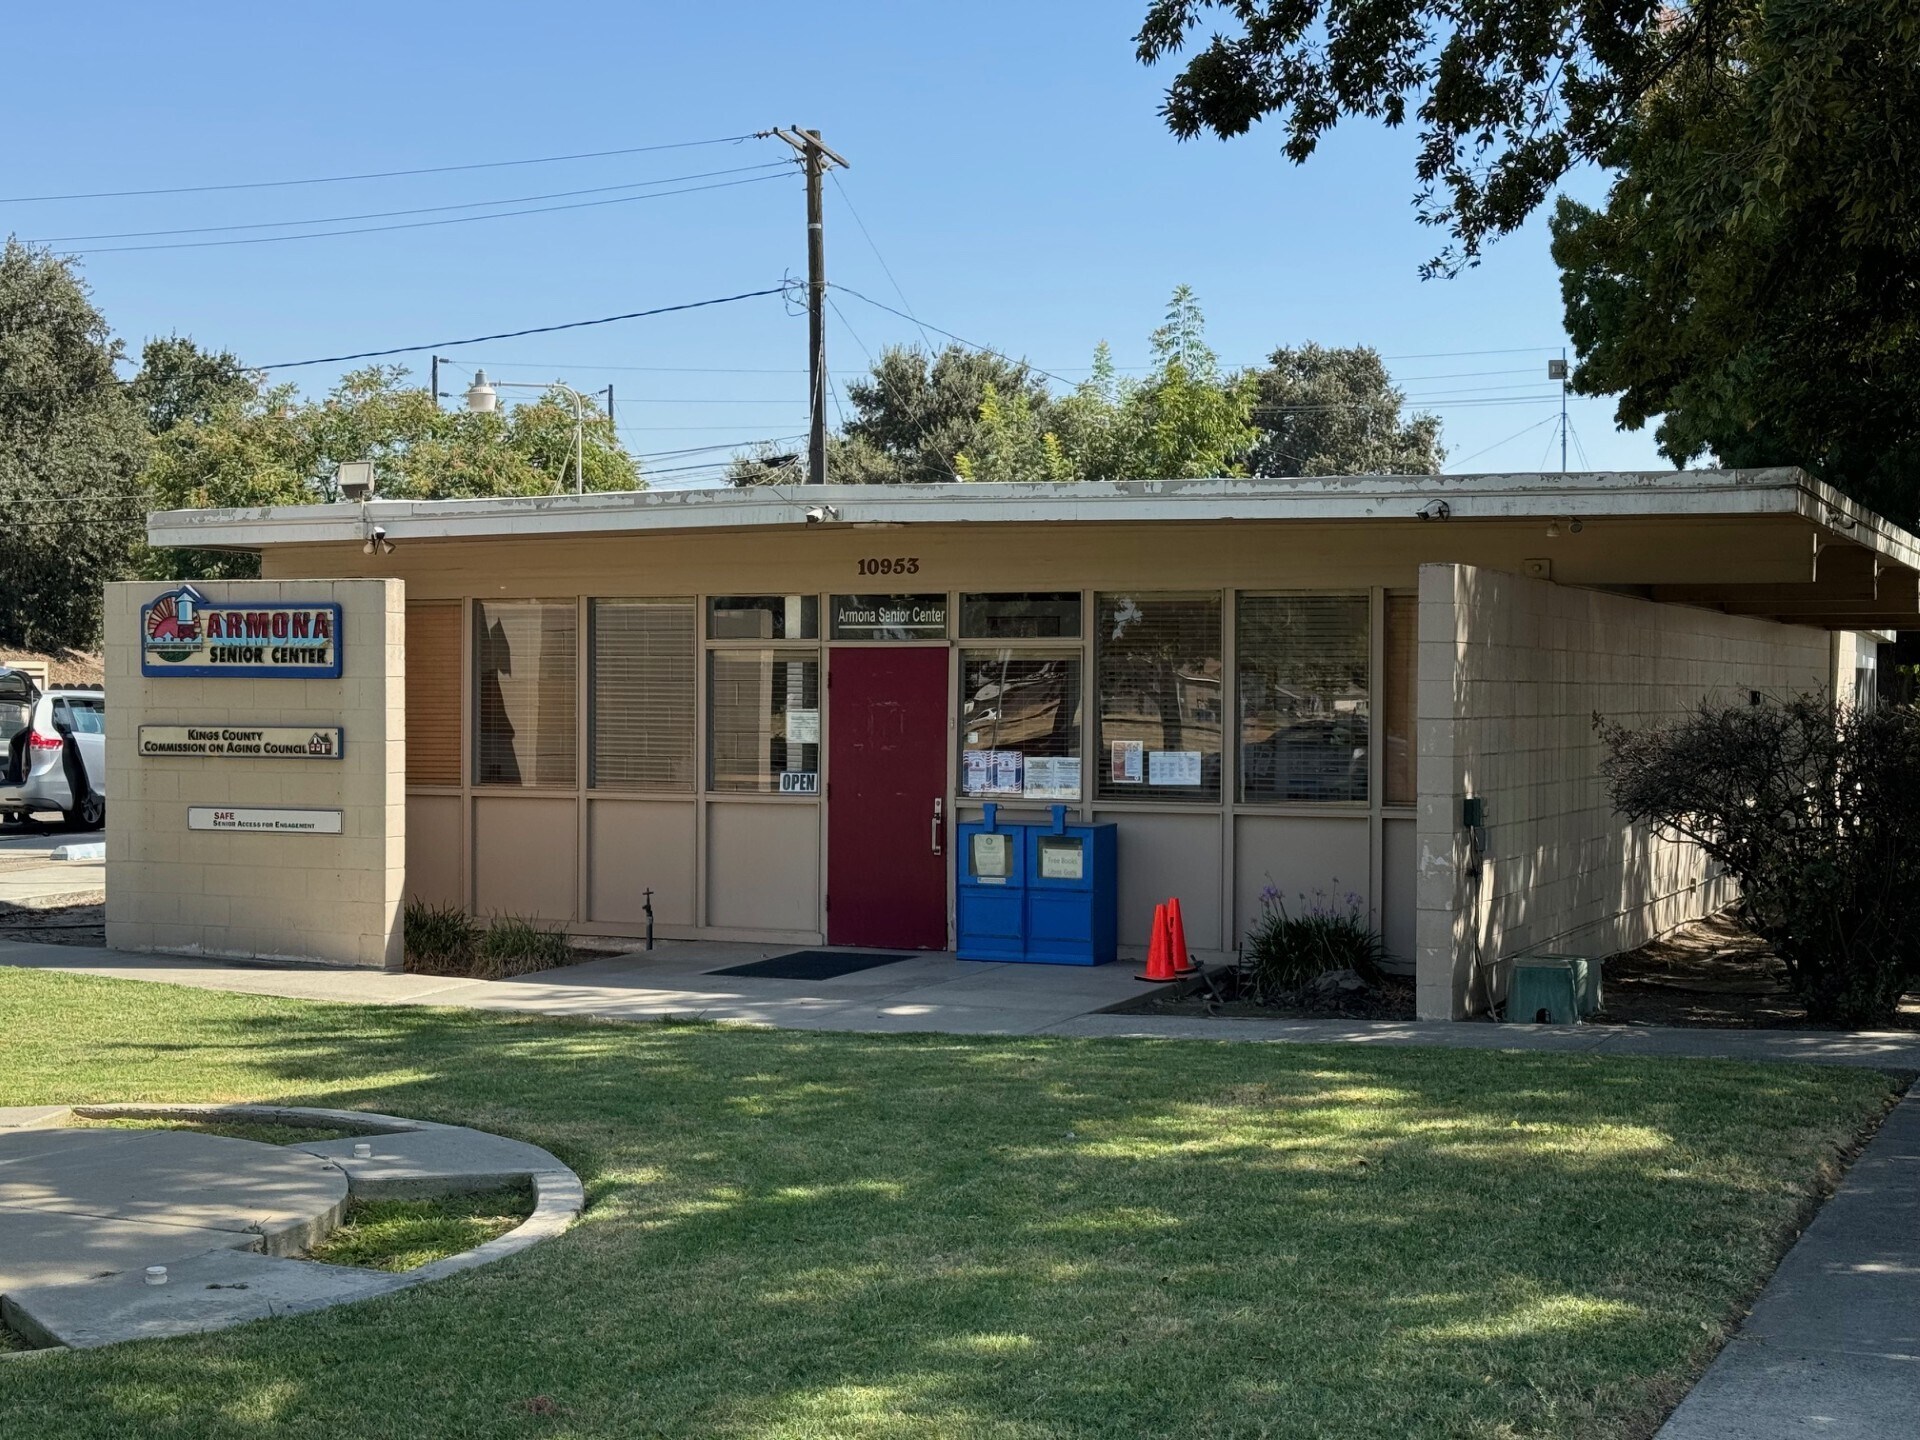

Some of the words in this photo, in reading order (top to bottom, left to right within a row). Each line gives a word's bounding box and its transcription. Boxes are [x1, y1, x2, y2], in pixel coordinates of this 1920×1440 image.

[857, 557, 920, 575] 10953
[838, 607, 876, 623] Armona
[878, 607, 910, 623] Senior
[912, 606, 945, 622] Center
[206, 612, 330, 639] ARMONA
[209, 646, 264, 664] SENIOR
[271, 647, 327, 664] CENTER
[187, 729, 220, 741] KINGS
[222, 730, 263, 742] COUNTY
[782, 774, 816, 791] OPEN
[213, 811, 235, 820] SAFE
